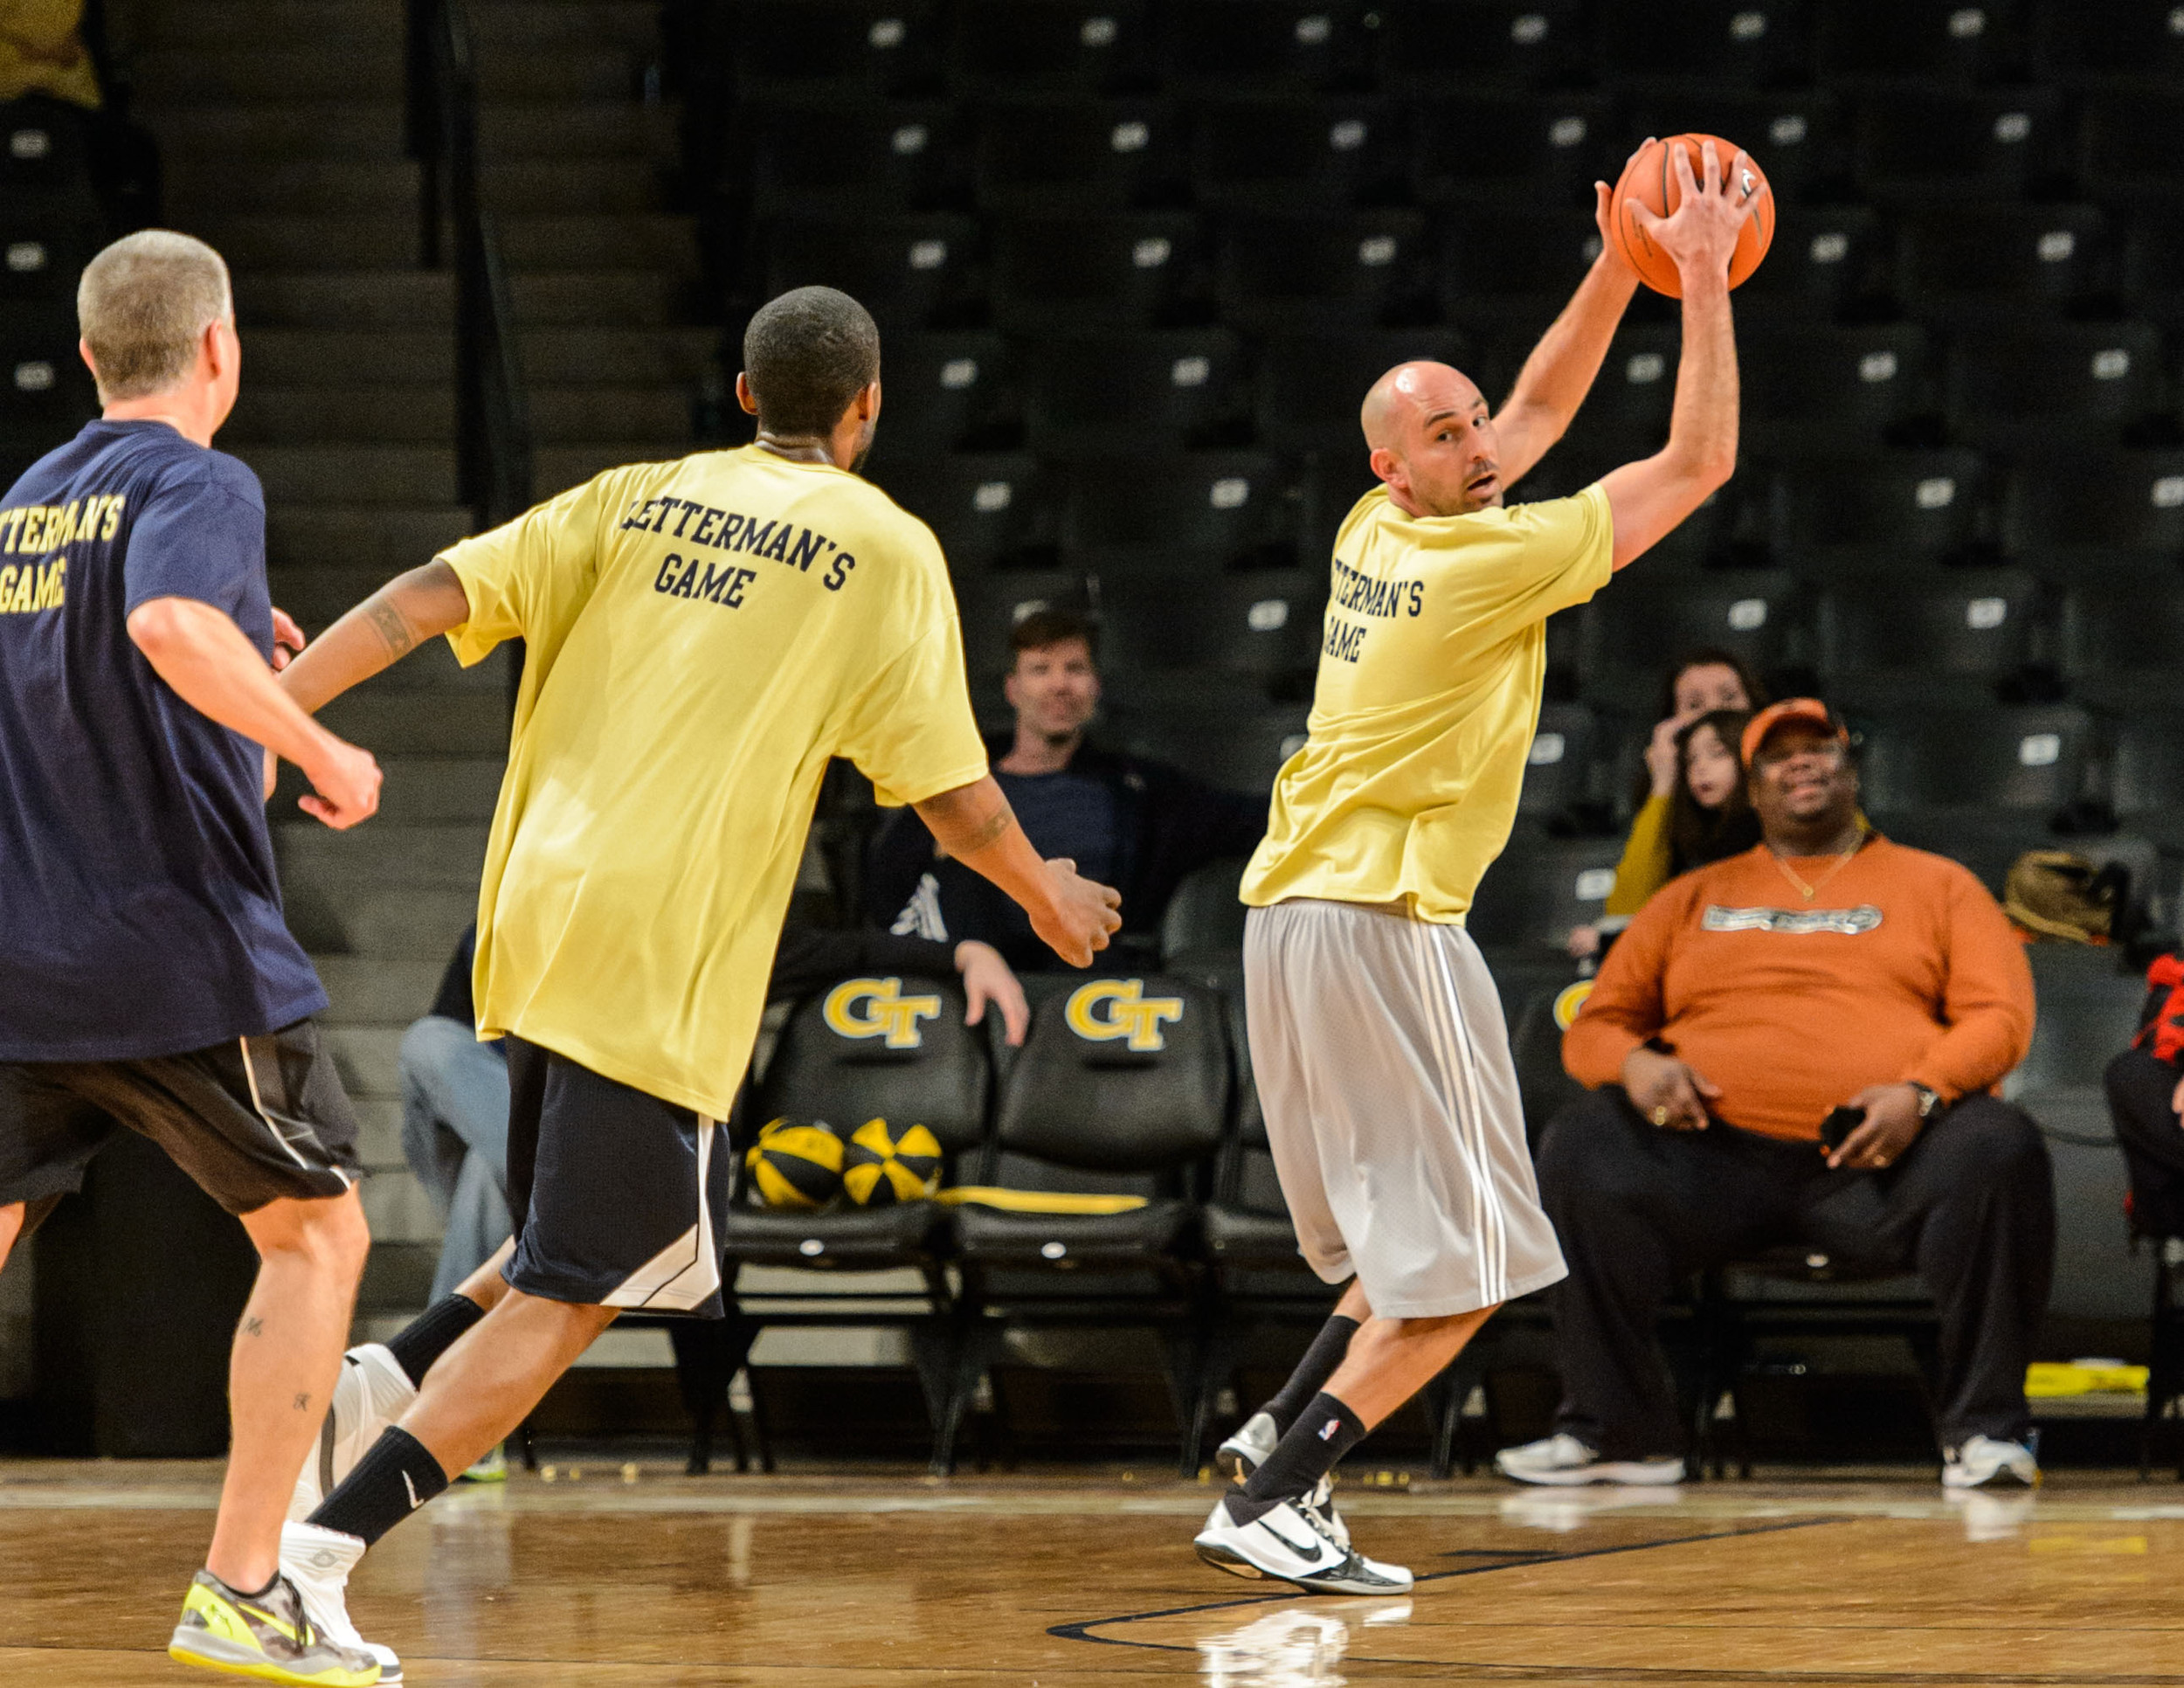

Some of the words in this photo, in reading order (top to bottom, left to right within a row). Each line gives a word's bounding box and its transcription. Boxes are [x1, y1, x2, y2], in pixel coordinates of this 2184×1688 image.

[654, 552, 757, 610] GAME
[1324, 615, 1367, 663] AME
[823, 976, 942, 1048] GT
[1065, 978, 1185, 1051] GT
